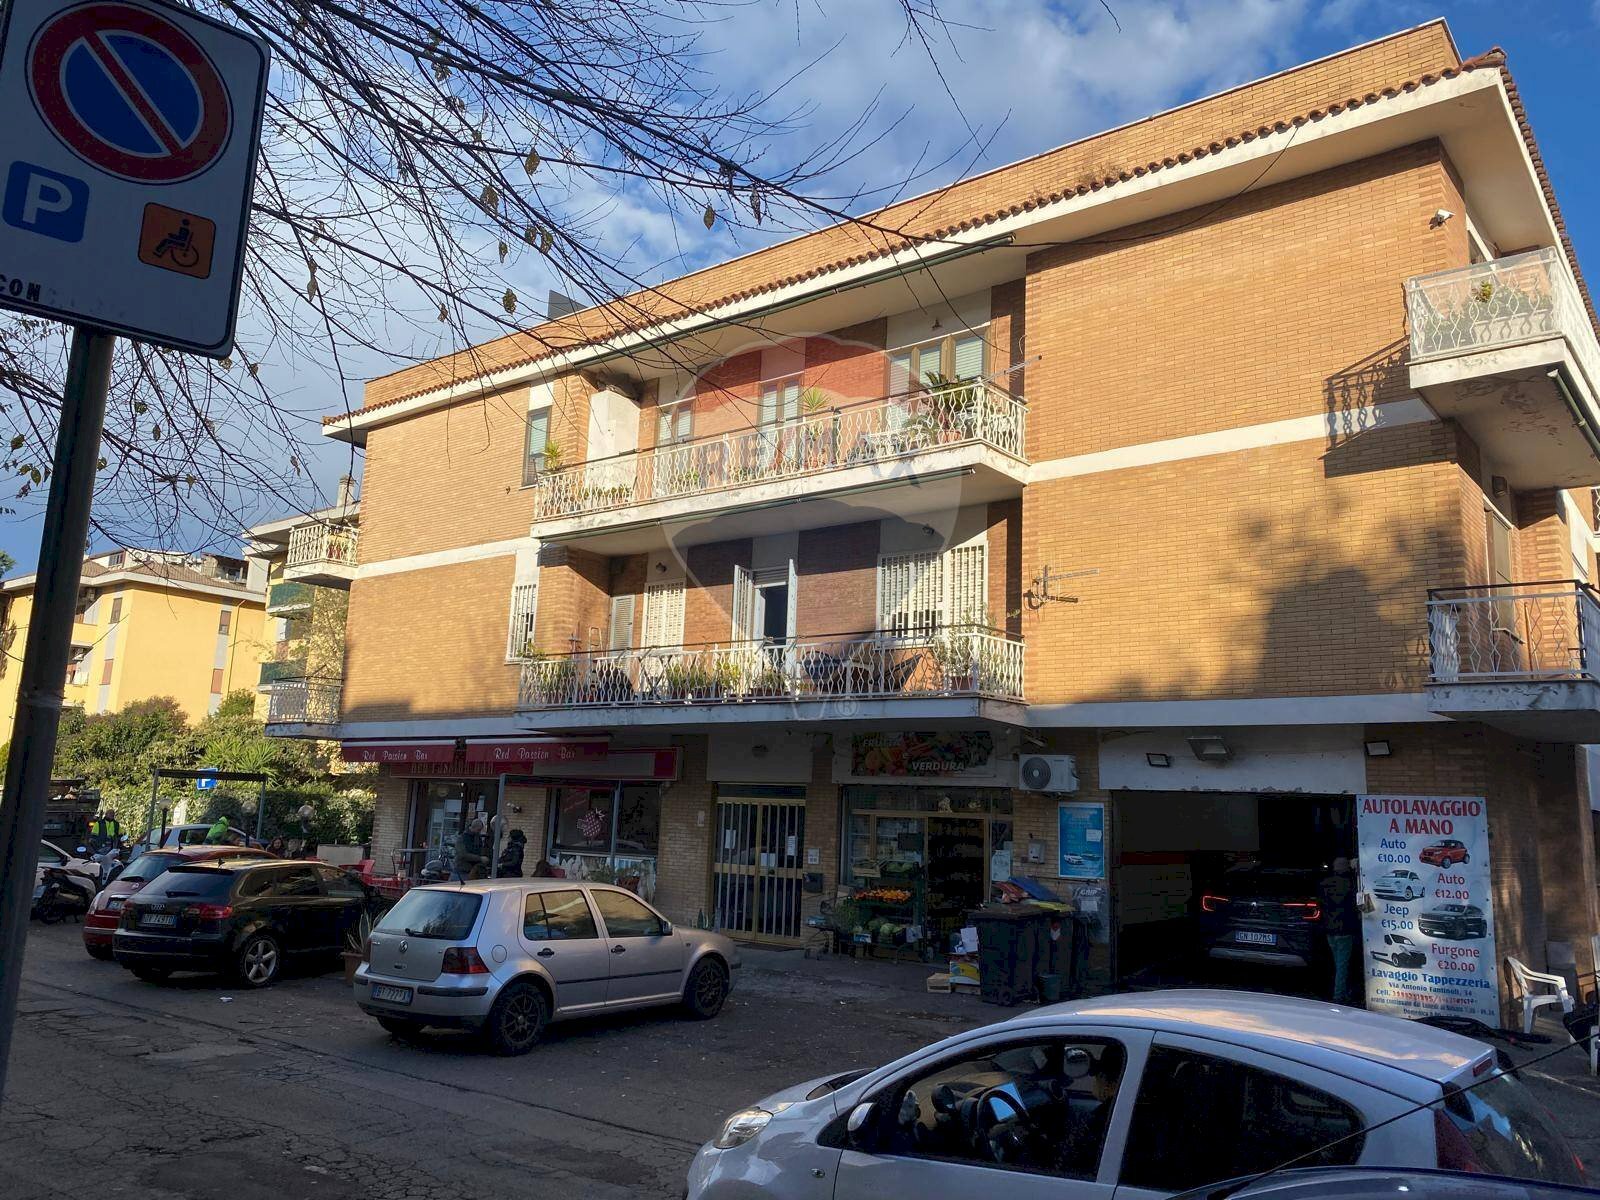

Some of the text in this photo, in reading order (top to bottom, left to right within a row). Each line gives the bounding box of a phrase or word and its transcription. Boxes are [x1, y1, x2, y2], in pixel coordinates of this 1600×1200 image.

[22, 172, 73, 225] P
[362, 750, 428, 761] Red Passion Bar
[495, 747, 576, 760] Red Passion Bar
[912, 760, 965, 771] VERDURA
[1362, 798, 1481, 817] AUTOLAVAGGIO
[1389, 818, 1453, 835] A MANO
[1380, 838, 1407, 849] Auto
[1378, 853, 1411, 864] €10.00
[1437, 873, 1465, 885] Auto
[1435, 889, 1469, 900] €12.00
[1384, 903, 1409, 918] Jeep
[1381, 919, 1414, 931] €15.00
[1431, 943, 1480, 960] Furgone
[1437, 960, 1475, 972] €20.00
[1371, 968, 1491, 989] Lavaggio Tappezzeria
[1401, 983, 1428, 992] Antonio
